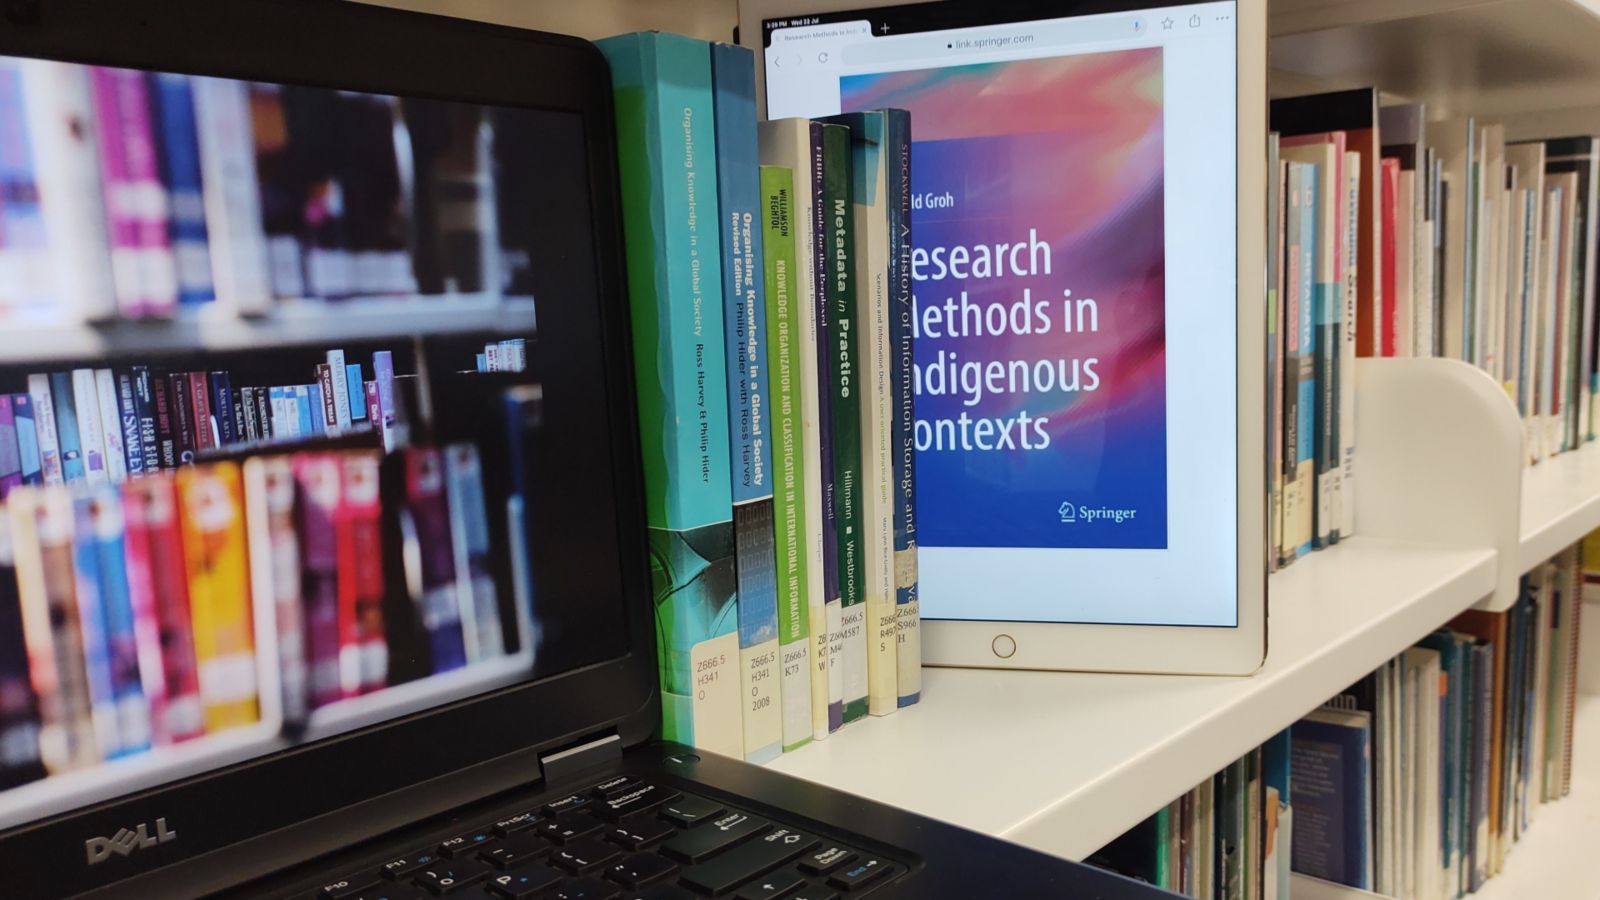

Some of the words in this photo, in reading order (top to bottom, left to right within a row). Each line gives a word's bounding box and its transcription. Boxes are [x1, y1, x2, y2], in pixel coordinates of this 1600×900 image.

[955, 34, 1034, 49] link.springer.com
[682, 107, 695, 168] Organising
[815, 146, 823, 183] FRBR:
[901, 143, 910, 214] STOCKWELL
[685, 172, 698, 232] Knowledge
[771, 195, 780, 231] BEGHTOL
[780, 189, 788, 237] WILLIAMSON
[926, 191, 954, 209] Groh
[689, 235, 699, 246] in
[731, 212, 743, 255] Revised
[835, 200, 848, 292] Metadata
[901, 224, 910, 238] A
[742, 212, 757, 286] Organising
[911, 228, 1051, 281] esearch
[691, 260, 702, 294] Global
[733, 259, 744, 296] Edition
[776, 260, 788, 319] KNOWLEDGE
[899, 243, 911, 306] History
[818, 274, 827, 327] Perplexed
[837, 300, 847, 312] in
[1064, 289, 1099, 333] in
[693, 298, 704, 337] Society
[735, 303, 747, 338] Philip
[746, 290, 759, 362] Knowledge
[902, 312, 911, 329] of
[695, 343, 705, 368] Ross
[736, 342, 748, 374] Hider
[778, 322, 791, 392] ORGANIZATION
[838, 319, 851, 398] Practice
[323, 369, 330, 378] TO
[335, 356, 347, 388] MERRY
[750, 366, 759, 379] in
[751, 382, 758, 390] a
[877, 371, 885, 395] Design
[902, 335, 914, 432] Information
[913, 350, 1100, 406] ndigenous
[196, 389, 206, 412] GRAVE
[219, 388, 228, 418] MORTAL
[324, 379, 333, 398] CATCH
[696, 371, 707, 408] Harvey
[739, 380, 749, 405] with
[336, 391, 349, 419] JONES
[699, 411, 708, 420] &
[751, 394, 763, 435] Global
[782, 395, 791, 415] AND
[124, 416, 141, 457] SNAKE
[199, 414, 208, 444] MATTER
[223, 420, 232, 440] ARTS
[699, 423, 710, 453] Philip
[740, 409, 750, 440] Ross
[914, 410, 1051, 451] ontexts
[742, 446, 752, 487] Harvey
[752, 439, 764, 486] Society
[782, 418, 795, 488] CLASSIFICATION
[901, 438, 915, 498] Storage
[701, 456, 710, 483] Hider
[785, 491, 794, 501] IN
[826, 482, 834, 520] Maxwell
[844, 470, 853, 519] Hillmann
[905, 504, 916, 534] and
[1079, 504, 1137, 523] Springer
[786, 505, 798, 574] INTERNATIONAL
[846, 540, 856, 606] Westbrooks
[789, 576, 801, 638] INFORMATION
[839, 626, 860, 639] M587
[880, 642, 886, 652] S
[897, 634, 906, 643] H
[750, 651, 775, 669] Z666.5
[784, 647, 807, 664] Z666.5
[784, 664, 799, 677] K73
[697, 671, 719, 686] H341
[751, 668, 770, 683] H341
[752, 695, 770, 711] 2008
[597, 777, 628, 790] Delete
[607, 785, 655, 805] Backspace
[548, 795, 579, 807] Insert
[713, 813, 741, 827] Enter
[85, 817, 177, 866] DELL
[443, 837, 464, 847] F12
[764, 829, 790, 842] Shift
[386, 859, 407, 869] F11
[814, 847, 839, 860] Page
[820, 850, 848, 864] Down
[497, 875, 512, 885] P
[847, 865, 866, 877] End
[324, 881, 349, 892] F10
